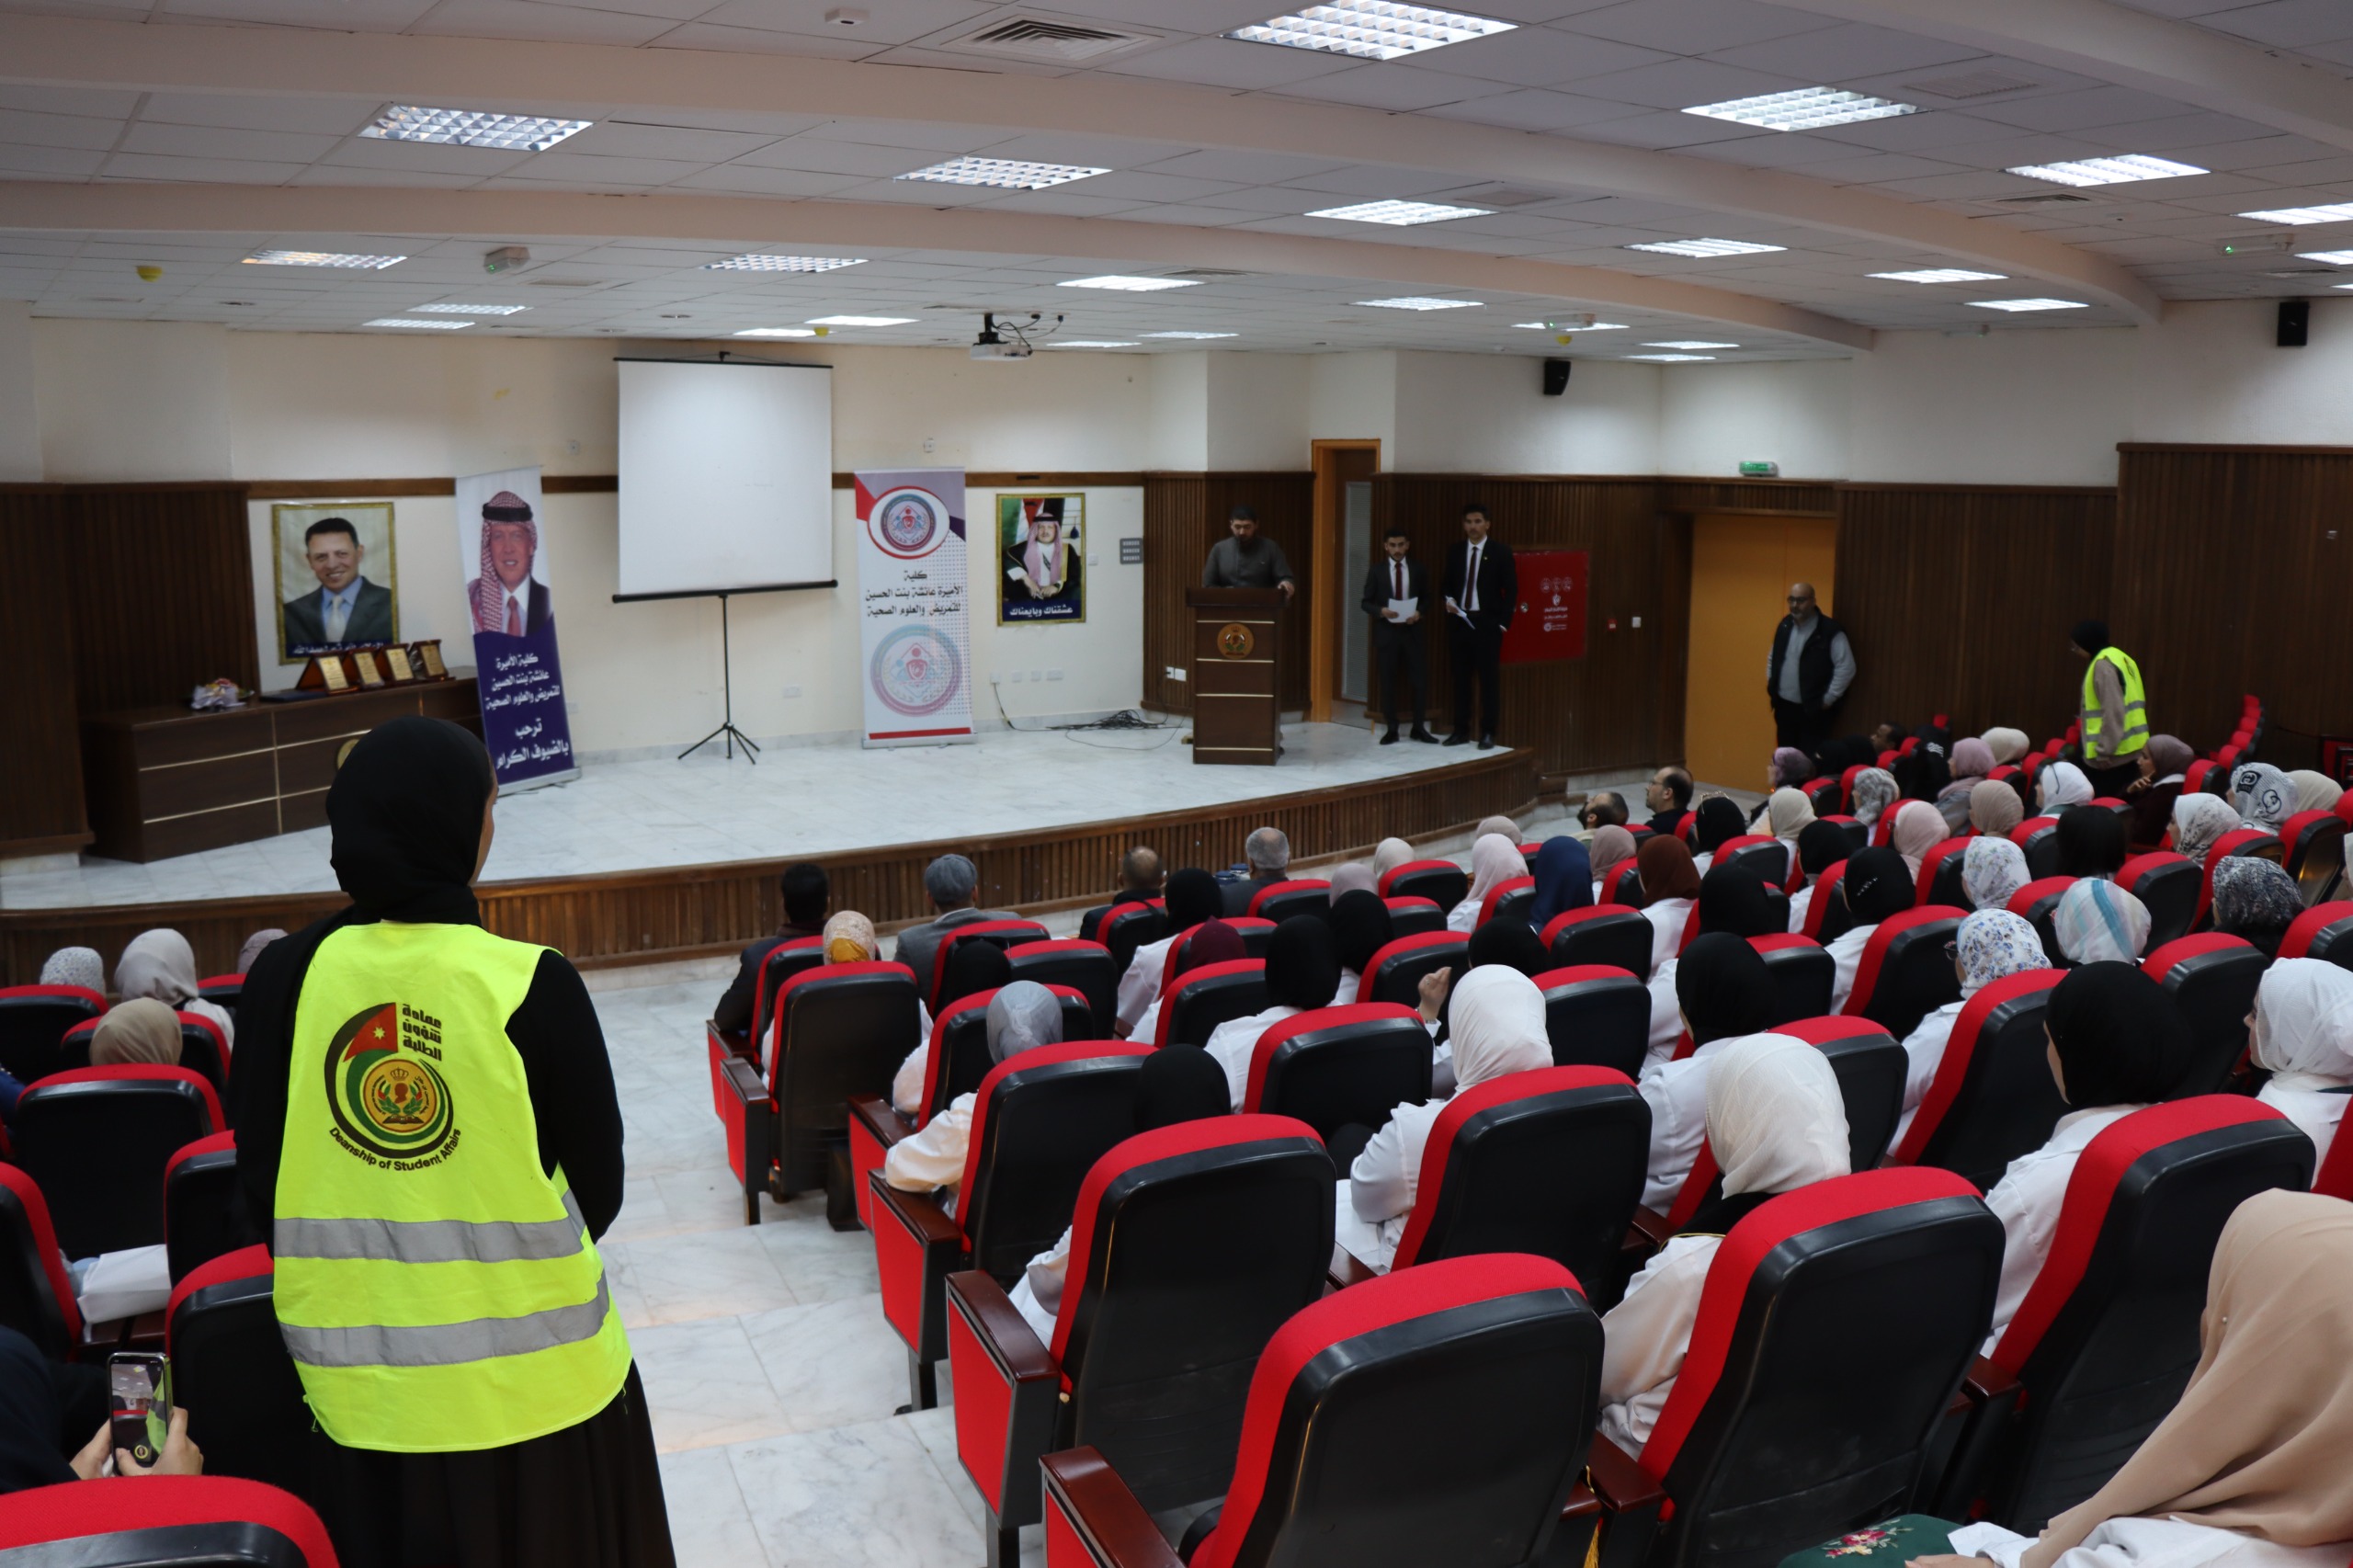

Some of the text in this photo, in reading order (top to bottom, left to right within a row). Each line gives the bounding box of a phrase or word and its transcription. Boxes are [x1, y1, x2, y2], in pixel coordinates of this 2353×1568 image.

[904, 570, 927, 582] كلية
[866, 588, 893, 601] الحسين
[895, 587, 910, 599] بنت
[868, 603, 961, 618] للتمريض والعلوم الصحية
[1009, 604, 1073, 617] عشقناك وبايعناك
[517, 653, 539, 667] كلية
[492, 675, 515, 691] الحسين
[485, 686, 560, 710] للتمريض والعلوم الصحية
[515, 718, 542, 739] ترحب
[496, 739, 569, 769] بالضيوف الكرام
[403, 1004, 441, 1028] عمادة
[403, 1018, 441, 1044] شؤون
[403, 1035, 442, 1062] الطلبة
[329, 1127, 461, 1171] Deanship of Student Affairs
